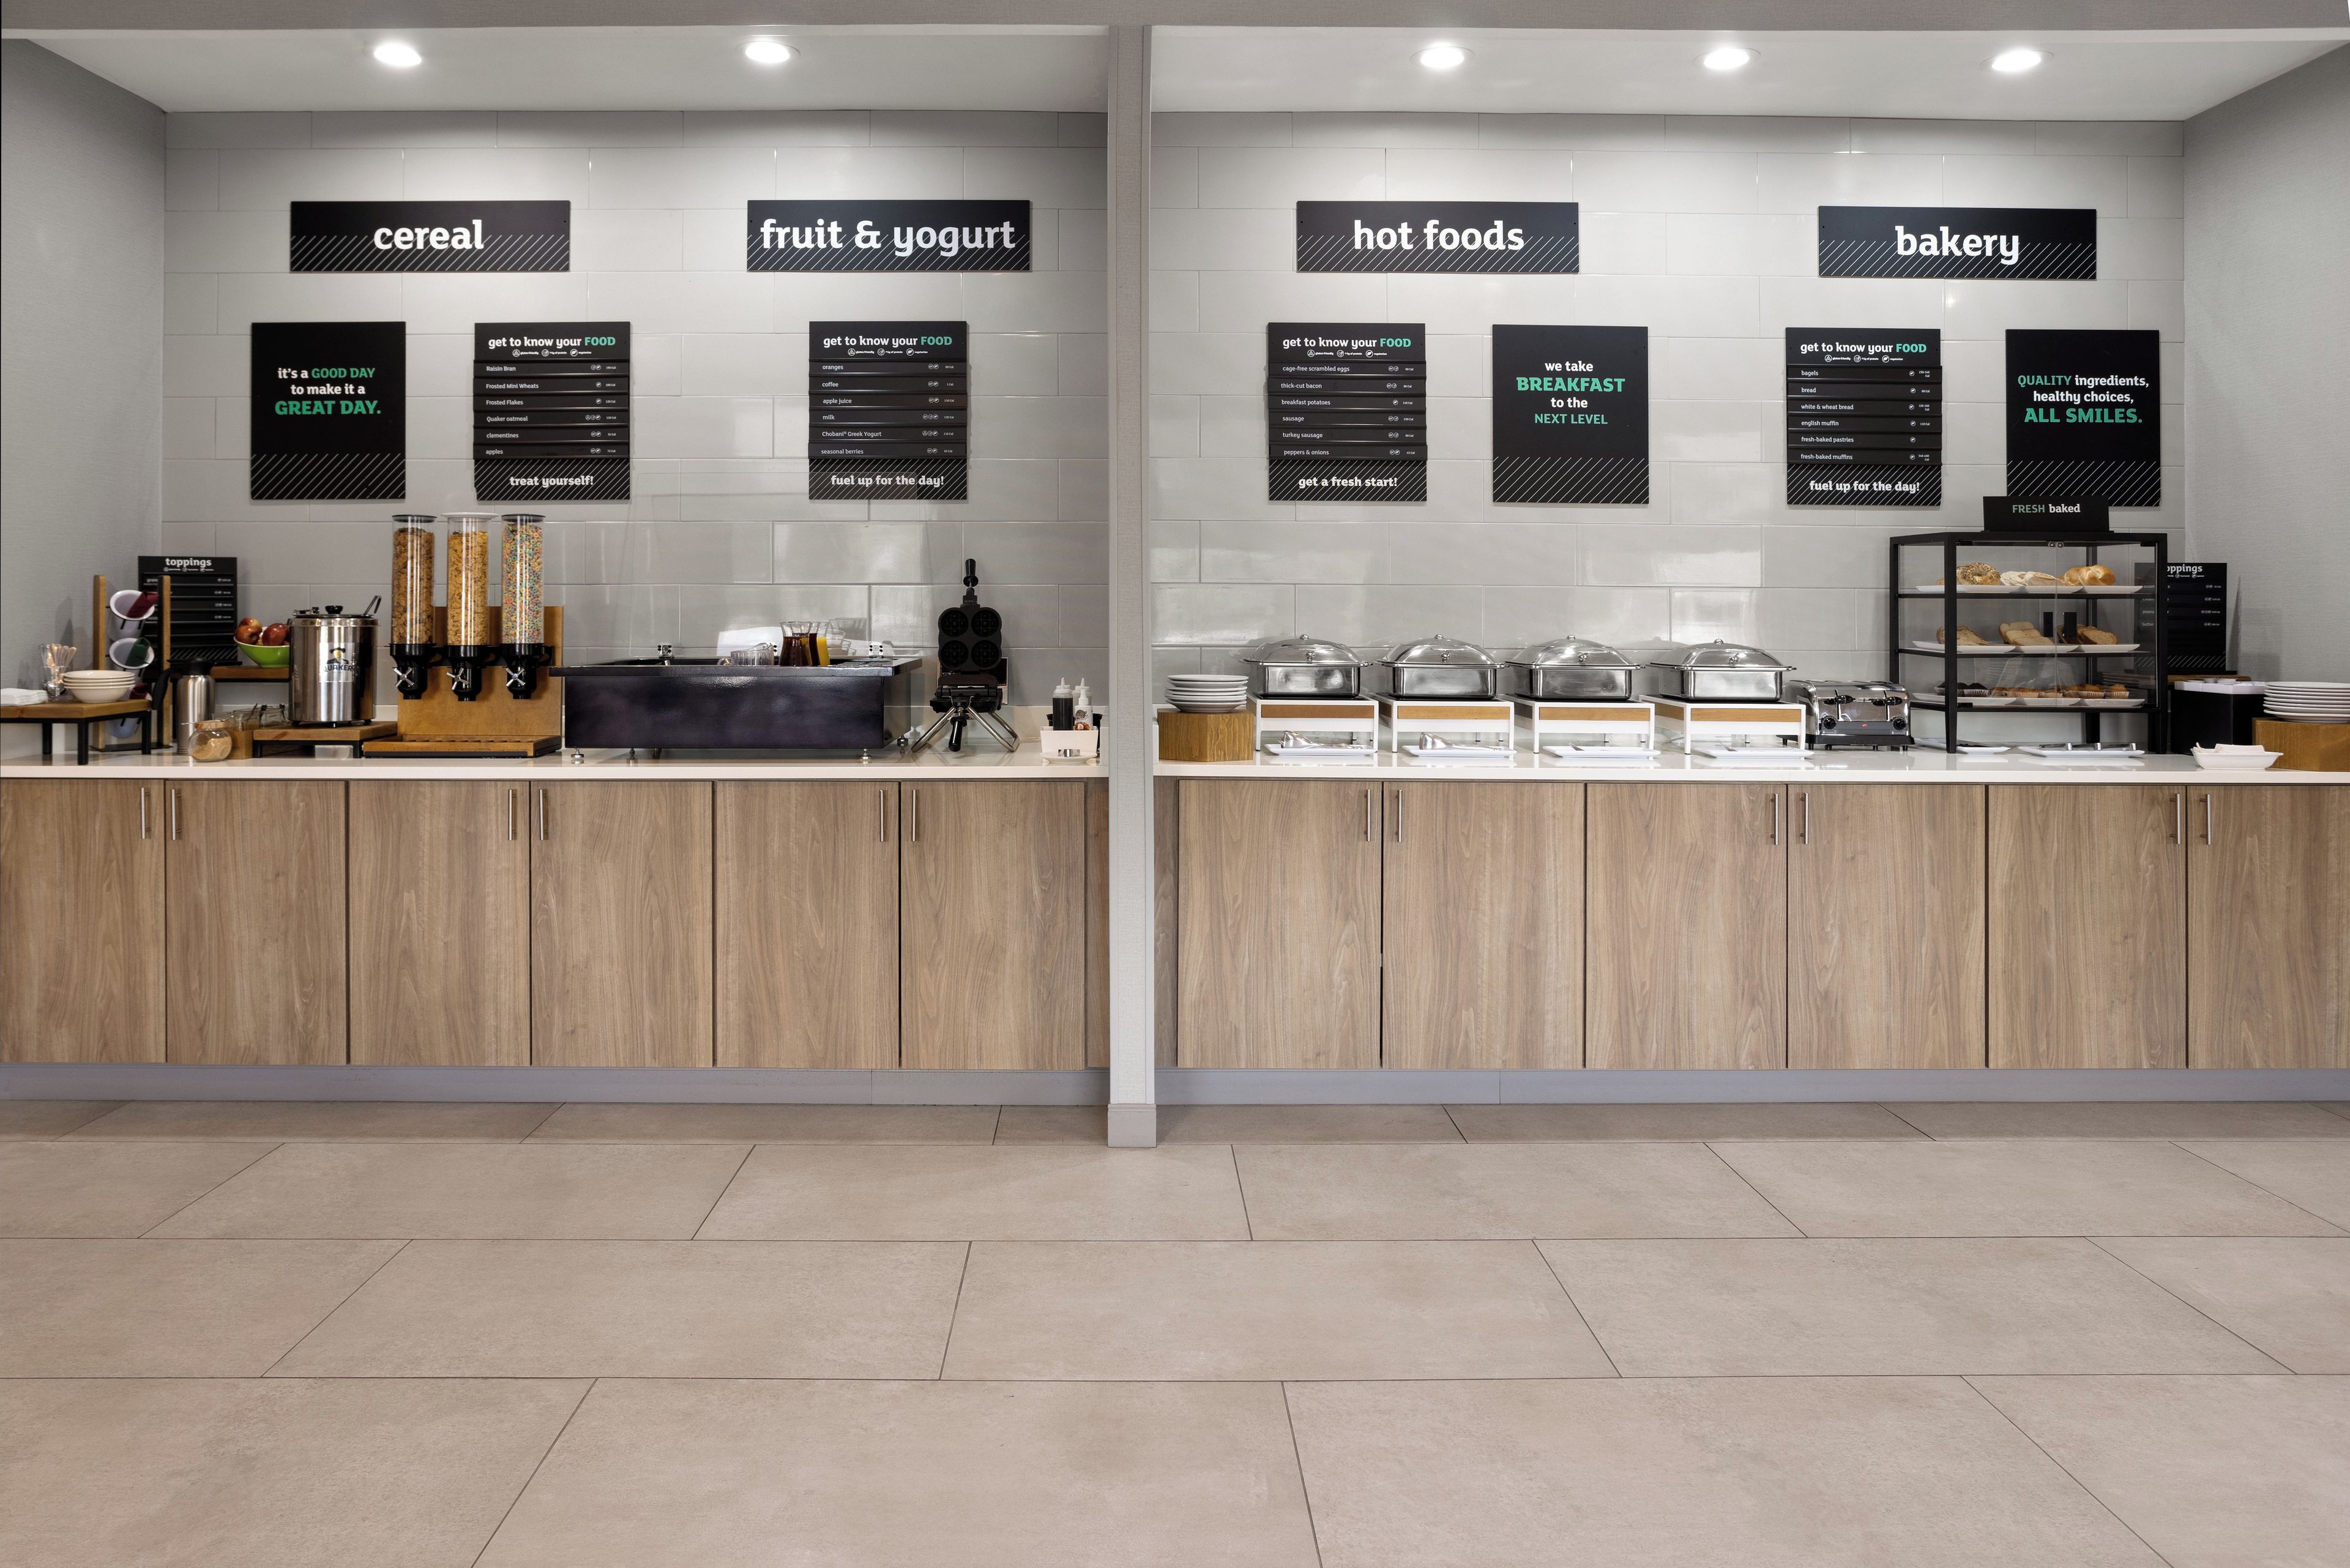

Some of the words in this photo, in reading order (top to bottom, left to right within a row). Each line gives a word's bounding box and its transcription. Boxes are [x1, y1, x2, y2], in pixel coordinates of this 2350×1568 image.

[374, 219, 484, 249] cereal
[760, 218, 843, 248] fruit
[854, 220, 882, 248] &
[893, 221, 1016, 256] yogurt
[1354, 220, 1414, 250] hot
[1423, 219, 1524, 250] foods
[1895, 225, 2019, 265] bakery
[488, 337, 507, 349] get
[509, 337, 521, 346] to
[523, 337, 554, 346] know
[556, 338, 582, 349] your
[585, 337, 616, 346] FOOD
[823, 336, 842, 348] get
[845, 336, 857, 346] to
[859, 335, 889, 345] know
[892, 338, 918, 348] your
[921, 337, 952, 345] FOOD
[1283, 337, 1302, 349] get
[1304, 337, 1316, 347] to
[1318, 337, 1349, 347] know
[1351, 340, 1377, 349] your
[1380, 338, 1411, 347] FOOD
[1800, 342, 1819, 354] get
[1821, 343, 1833, 352] to
[1835, 342, 1865, 352] know
[1868, 345, 1893, 355] your
[1896, 343, 1927, 353] FOOD
[1545, 363, 1562, 371] we
[1565, 360, 1594, 371] take
[277, 367, 298, 379] it's
[311, 368, 346, 378] GOOD
[350, 368, 375, 378] DAY
[1516, 377, 1625, 392] BREAKFAST
[2018, 375, 2072, 387] QUALITY
[2075, 375, 2149, 389] ingredients,
[290, 384, 304, 395] to
[307, 383, 341, 395] make
[344, 383, 355, 394] it
[357, 386, 365, 394] a
[1550, 397, 1564, 408] to
[1567, 397, 1588, 408] the
[2034, 390, 2081, 405] healthy
[2084, 391, 2133, 404] choices,
[275, 400, 335, 415] GREAT
[340, 400, 381, 414] DAY.
[1535, 413, 1567, 424] NEXT
[1571, 414, 1608, 424] LEVEL
[2024, 408, 2061, 422] ALL
[2066, 408, 2143, 423] SMILES.
[510, 476, 539, 485] treat
[542, 476, 594, 488] yourself!
[831, 476, 854, 485] fuel
[857, 477, 873, 487] up
[876, 476, 893, 485] for
[896, 476, 916, 485] the
[919, 476, 944, 487] day!
[1299, 478, 1318, 488] get
[1331, 477, 1362, 486] fresh
[1810, 481, 1833, 490] fuel
[1836, 483, 1851, 492] up
[1853, 481, 1870, 491] for
[1873, 482, 1892, 491] the
[1895, 482, 1919, 493] day!
[2013, 504, 2045, 513] FRESH
[2048, 503, 2081, 513] baked
[165, 558, 212, 569] toppings
